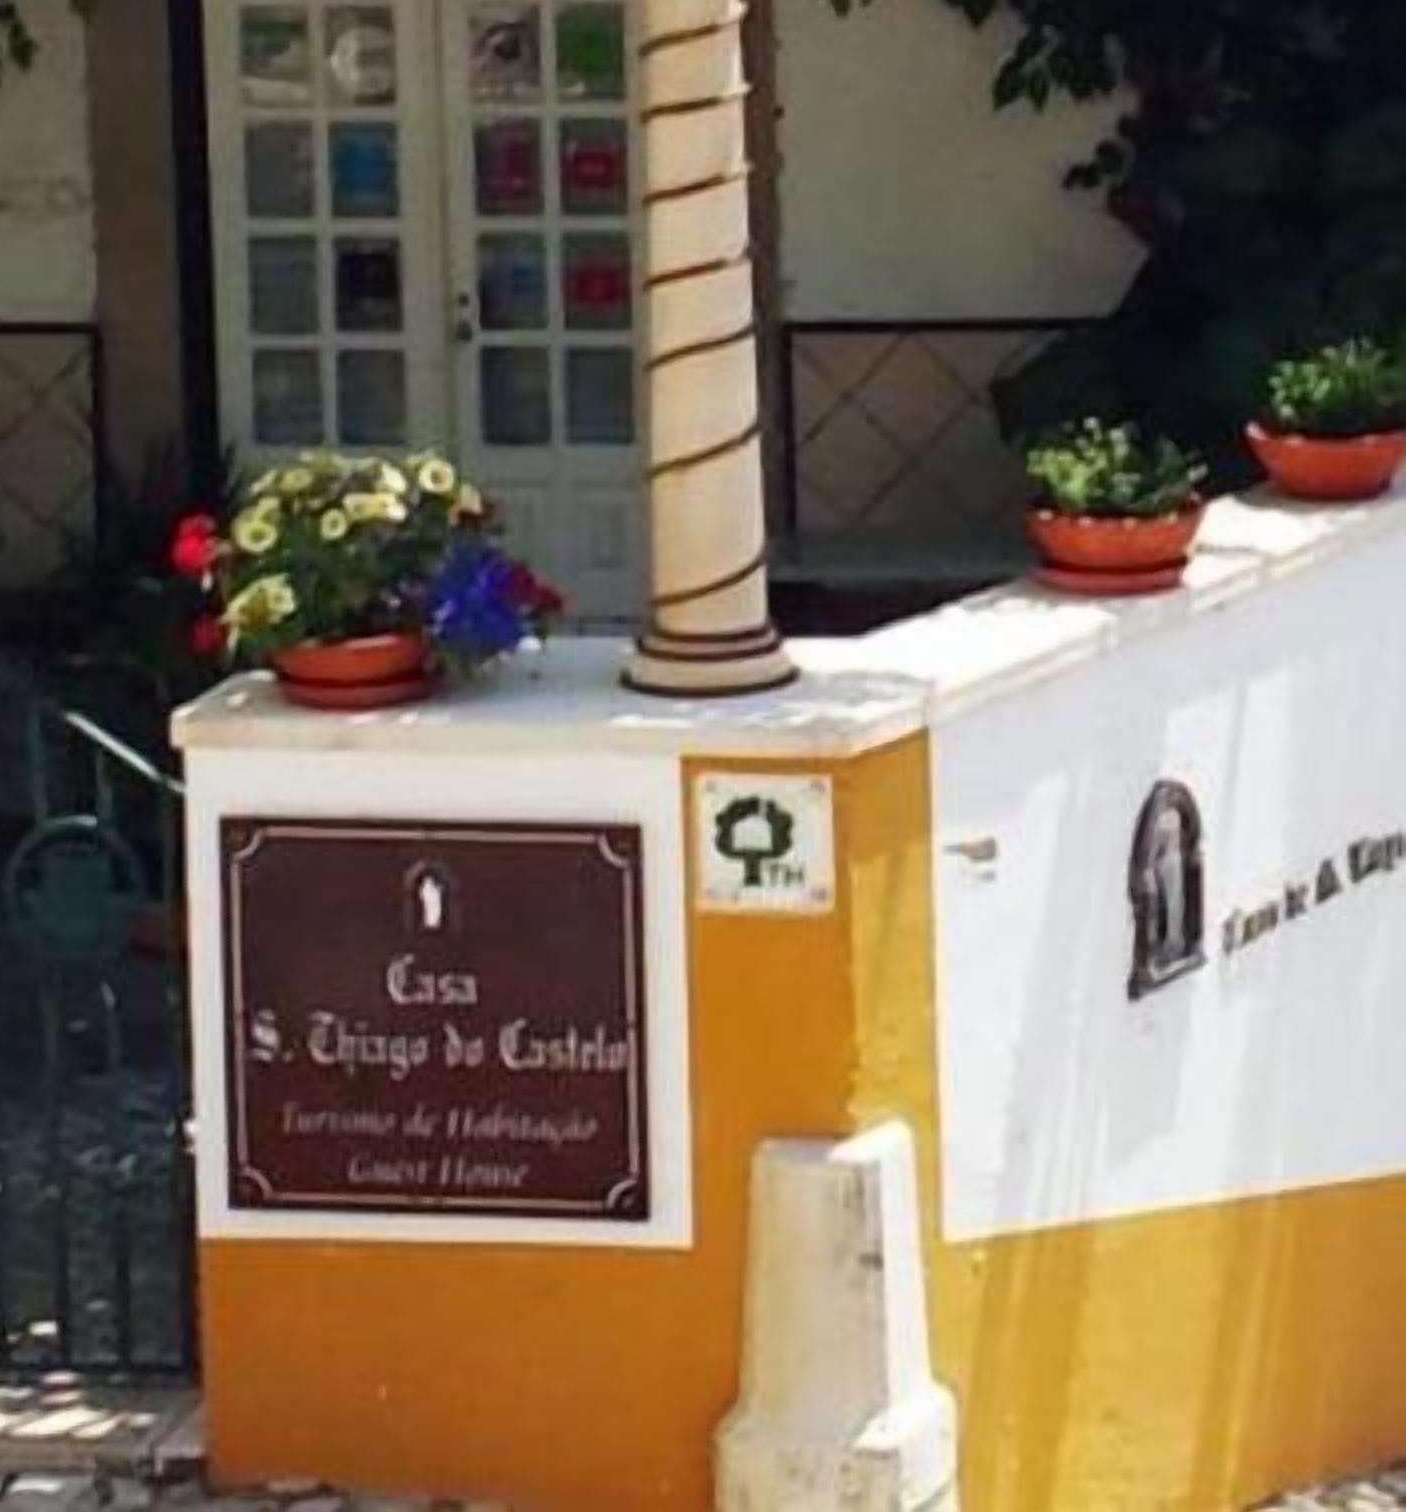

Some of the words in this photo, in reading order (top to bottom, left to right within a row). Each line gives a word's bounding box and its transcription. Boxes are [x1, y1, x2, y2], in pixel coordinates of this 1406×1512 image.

[387, 953, 478, 1005] Casa
[247, 1008, 294, 1064] S.
[308, 1010, 429, 1081] Thiago
[443, 1020, 485, 1068] do
[498, 1017, 628, 1072] Castelo
